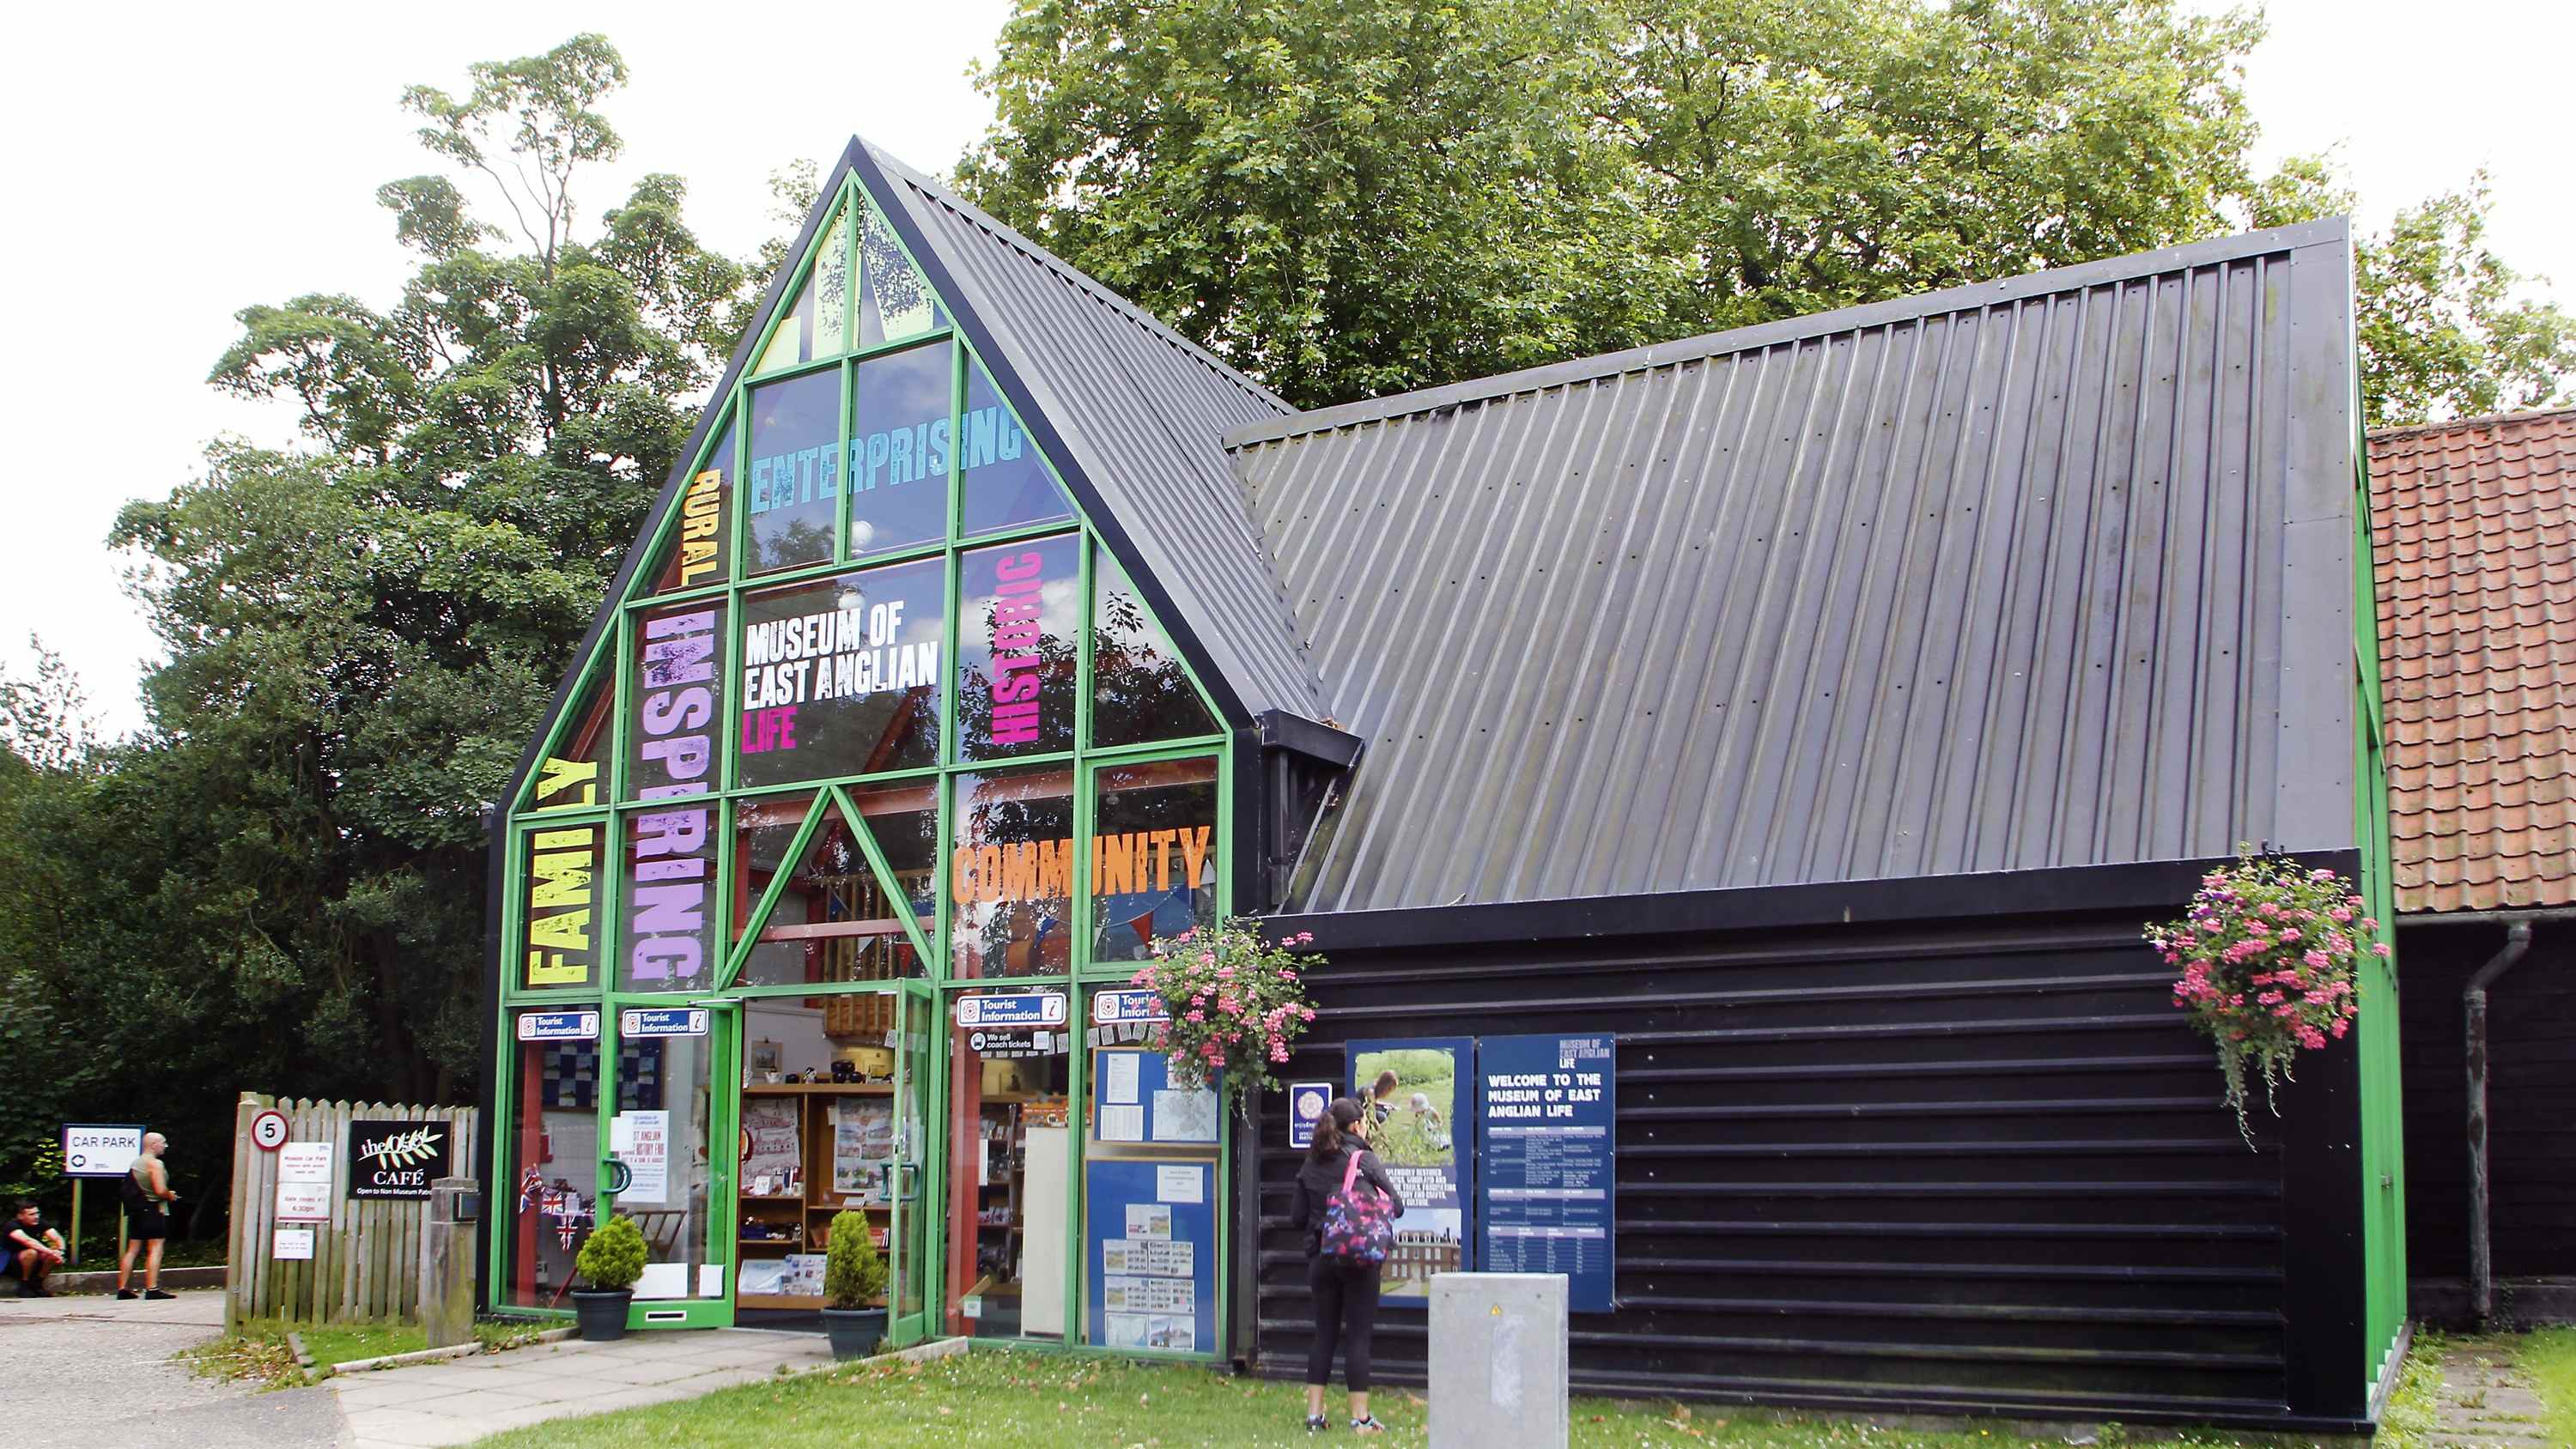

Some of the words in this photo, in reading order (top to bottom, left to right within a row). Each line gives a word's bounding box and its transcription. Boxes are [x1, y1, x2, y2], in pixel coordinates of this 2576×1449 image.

[750, 406, 1024, 515] ENTERPRISING
[681, 469, 721, 586] RURAL
[745, 608, 861, 667] MUSEUM
[869, 600, 904, 648] OF
[992, 552, 1044, 745] HISTORIC
[744, 661, 811, 710] EAST
[814, 641, 939, 699] ANGLIAN
[742, 706, 798, 754] LIFE
[631, 610, 714, 982] INSPIRING
[528, 756, 598, 986] FAMILY
[952, 826, 1212, 906] COMMUNITY
[981, 998, 1018, 1010] Tourist
[537, 1016, 563, 1025] Tourist
[641, 1013, 670, 1022] Tourist
[981, 1011, 1041, 1022] Information
[537, 1026, 580, 1036] Information
[641, 1022, 689, 1033] Information
[999, 1033, 1011, 1041] sell
[1559, 1040, 1591, 1049] MUSEUM
[1592, 1039, 1601, 1048] OF
[1559, 1048, 1577, 1058] EAST
[1578, 1047, 1610, 1058] ANGLIAN
[1559, 1058, 1575, 1069] LIFE
[1488, 1075, 1546, 1087] WELCOME
[1552, 1074, 1571, 1086] TO
[1577, 1073, 1601, 1086] THE
[1488, 1089, 1539, 1102] MUSEUM
[1545, 1089, 1563, 1101] OF
[1568, 1088, 1601, 1101] EAST
[1488, 1105, 1541, 1118] ANGLIAN
[1546, 1104, 1573, 1117] LIFE
[264, 1123, 276, 1138] 5
[641, 1131, 661, 1141] ANGLIAN
[72, 1136, 99, 1148] CAR
[103, 1137, 137, 1148] PARK
[361, 1139, 386, 1157] the
[373, 1168, 425, 1185] CAFÉ
[356, 1187, 373, 1196] Open
